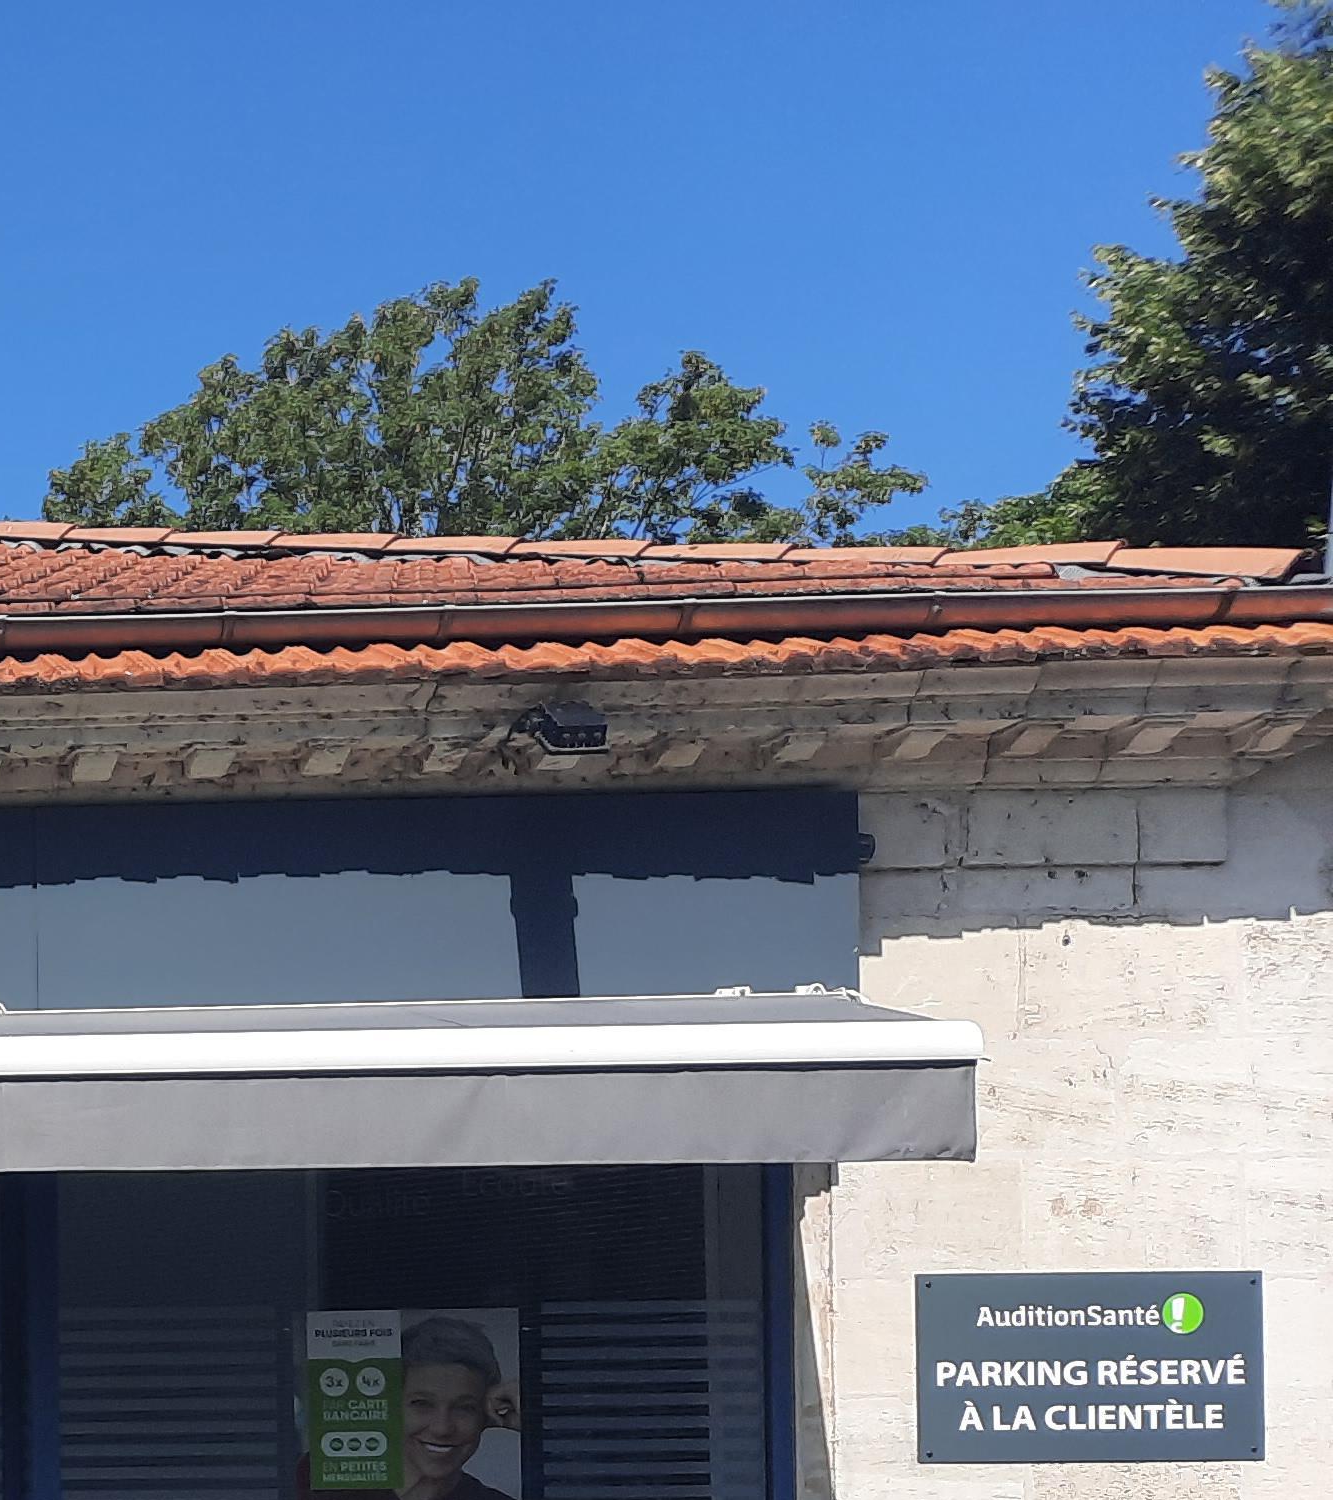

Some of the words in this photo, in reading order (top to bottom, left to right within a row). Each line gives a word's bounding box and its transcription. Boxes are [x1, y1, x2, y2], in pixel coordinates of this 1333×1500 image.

[976, 1304, 1160, 1327] AuditionSanté
[936, 1360, 1088, 1387] PARKING
[1097, 1353, 1247, 1386] RÉSERVÉ
[348, 1399, 388, 1410] CARTE
[323, 1409, 388, 1421] BANCAIRE
[959, 1400, 984, 1431] À
[992, 1404, 1037, 1431] LA
[1044, 1398, 1225, 1431] CLIENTÈLE
[341, 1461, 388, 1472] PETITES
